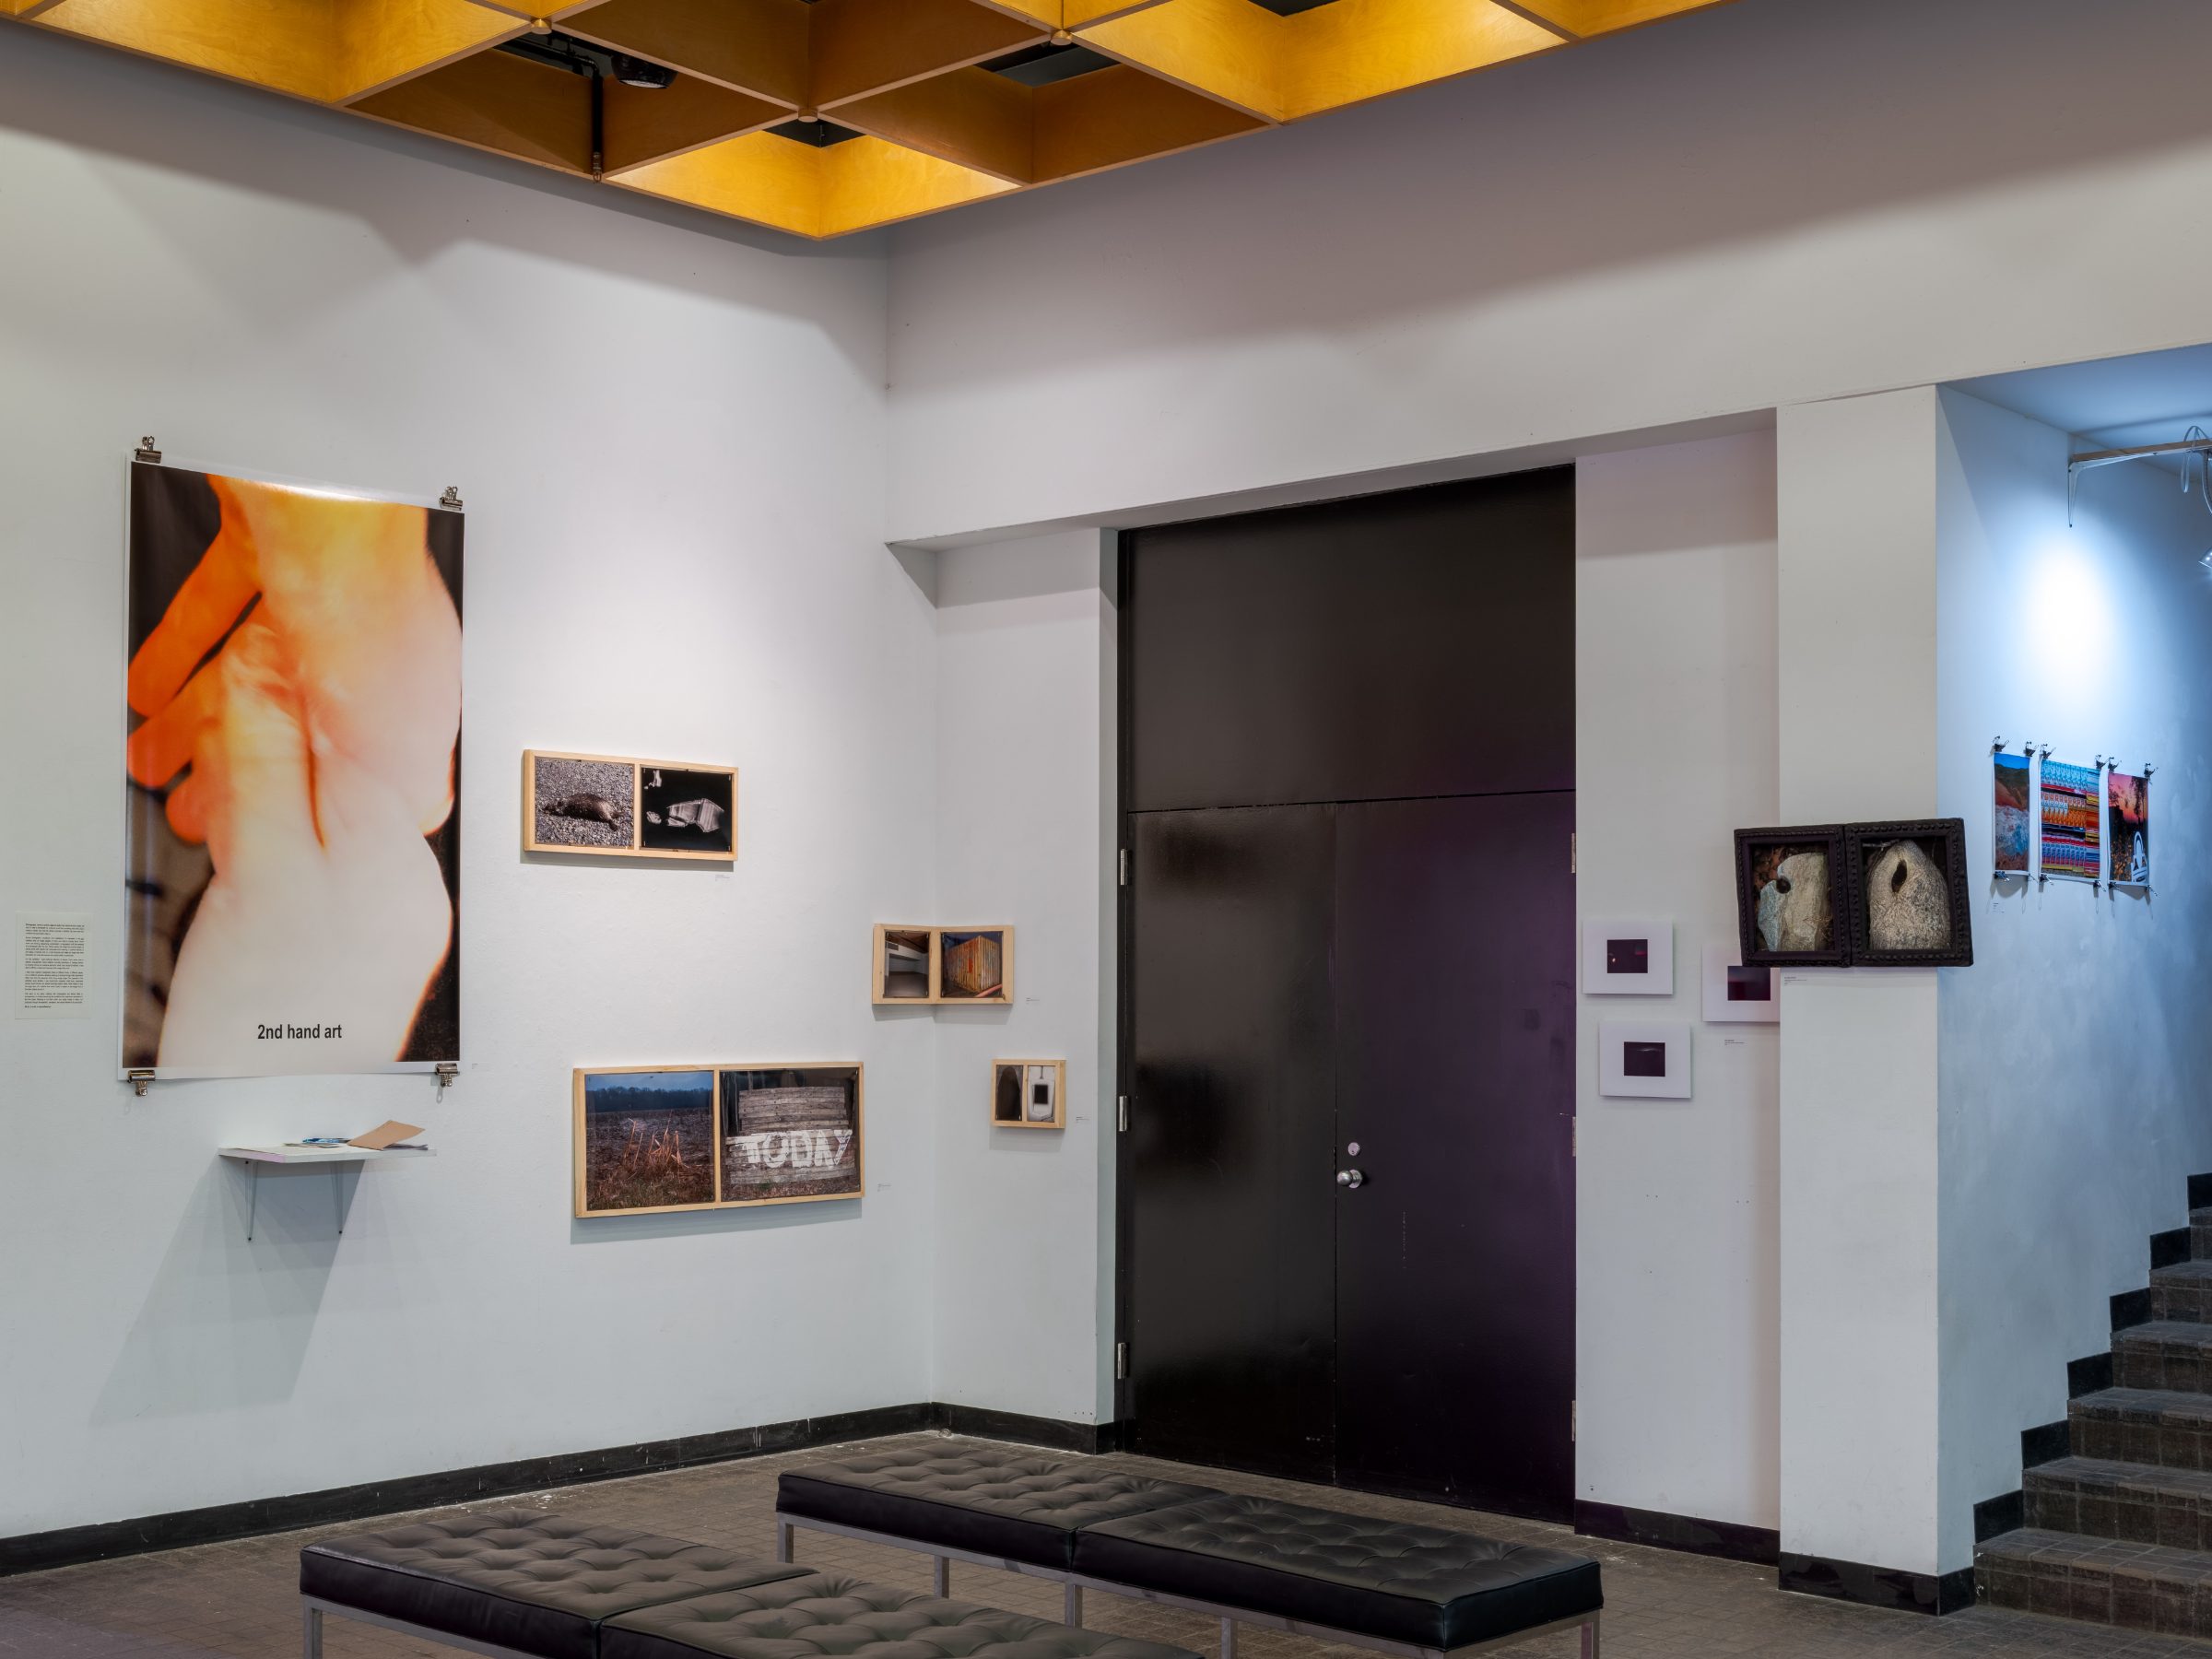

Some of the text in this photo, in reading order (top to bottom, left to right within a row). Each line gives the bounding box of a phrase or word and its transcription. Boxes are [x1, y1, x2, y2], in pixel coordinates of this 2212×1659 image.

[258, 1024, 342, 1039] 2nd hand art
[736, 1129, 853, 1169] TODAY
